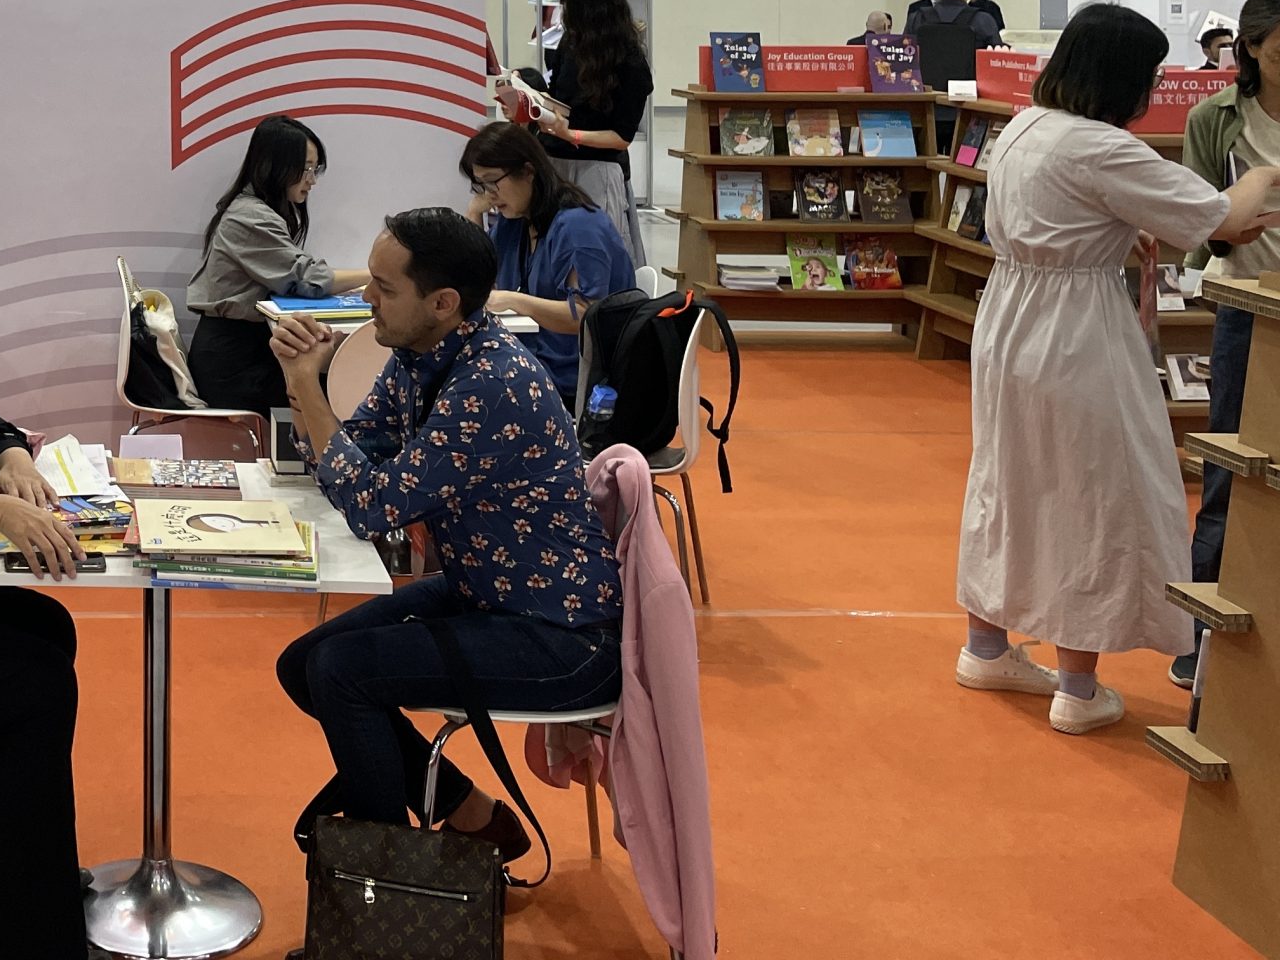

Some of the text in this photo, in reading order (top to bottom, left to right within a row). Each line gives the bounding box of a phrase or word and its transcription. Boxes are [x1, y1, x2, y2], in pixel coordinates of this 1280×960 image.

[724, 44, 747, 52] Tales
[742, 53, 757, 61] Joy
[767, 53, 854, 62] Joy Education Group
[1156, 80, 1179, 90] OW
[1182, 80, 1204, 91] CO.,
